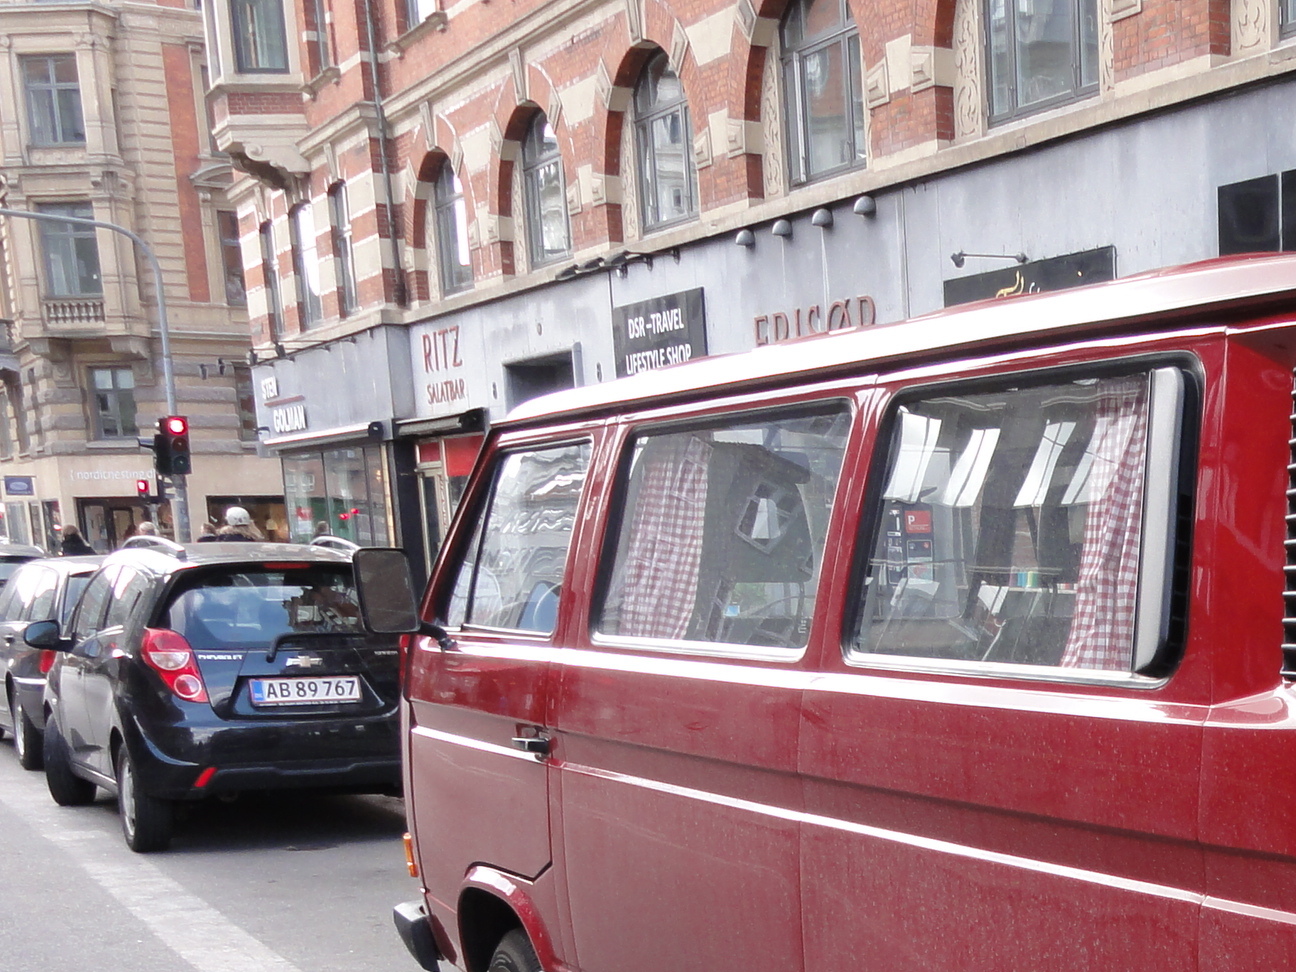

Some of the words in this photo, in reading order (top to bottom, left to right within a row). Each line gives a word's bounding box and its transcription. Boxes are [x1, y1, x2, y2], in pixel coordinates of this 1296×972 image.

[422, 324, 463, 374] RITZ
[625, 348, 665, 375] LIFESTYLE
[666, 343, 692, 366] SHOP
[427, 378, 466, 405] SALATBAR
[267, 682, 291, 699] AB
[296, 681, 318, 698] 89
[322, 680, 356, 697] 767
